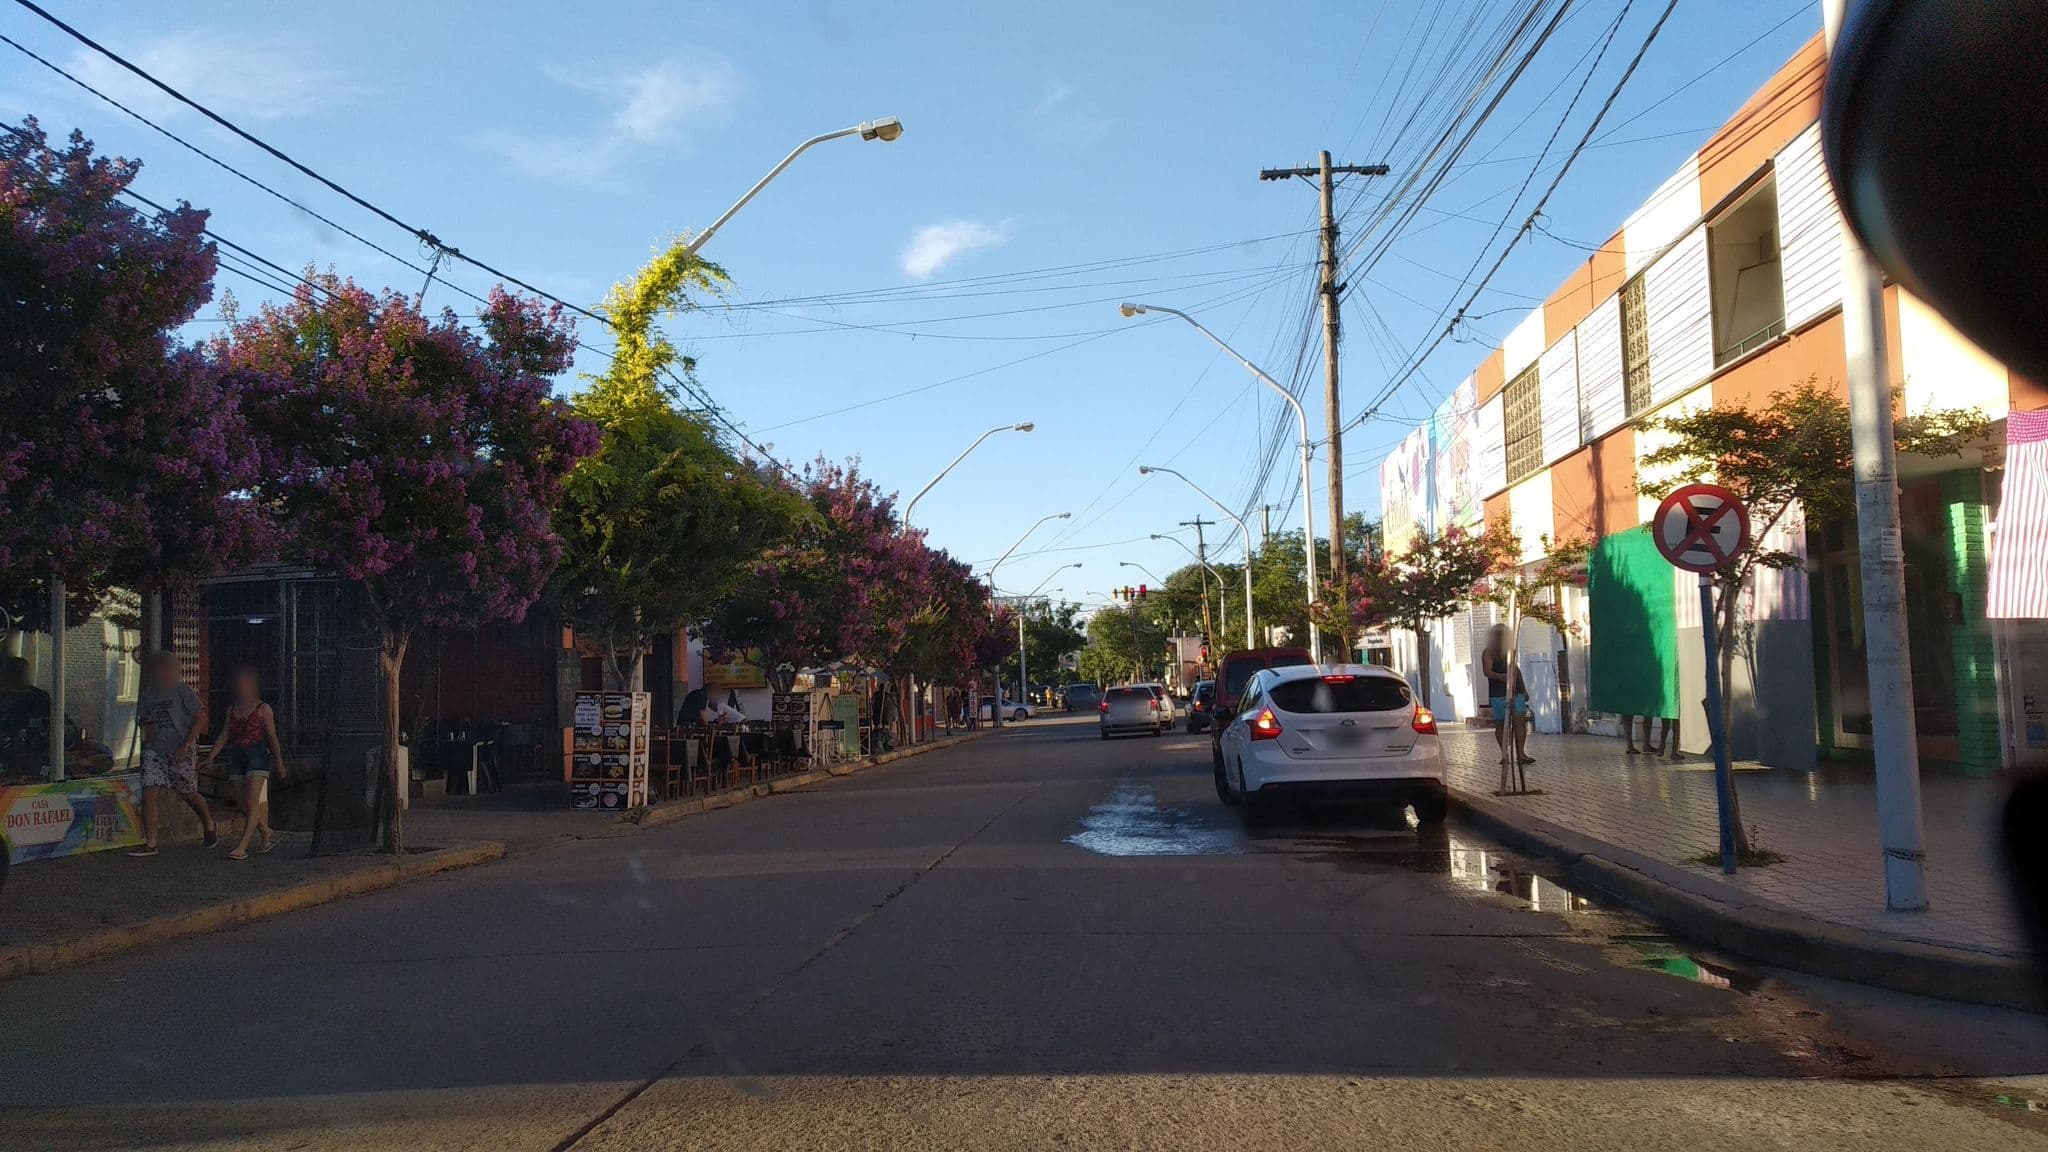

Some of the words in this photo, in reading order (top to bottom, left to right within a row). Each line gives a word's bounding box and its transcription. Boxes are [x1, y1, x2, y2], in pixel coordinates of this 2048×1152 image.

[32, 800, 48, 809] CASA
[7, 813, 31, 828] DON
[33, 809, 72, 825] RAFAEL
